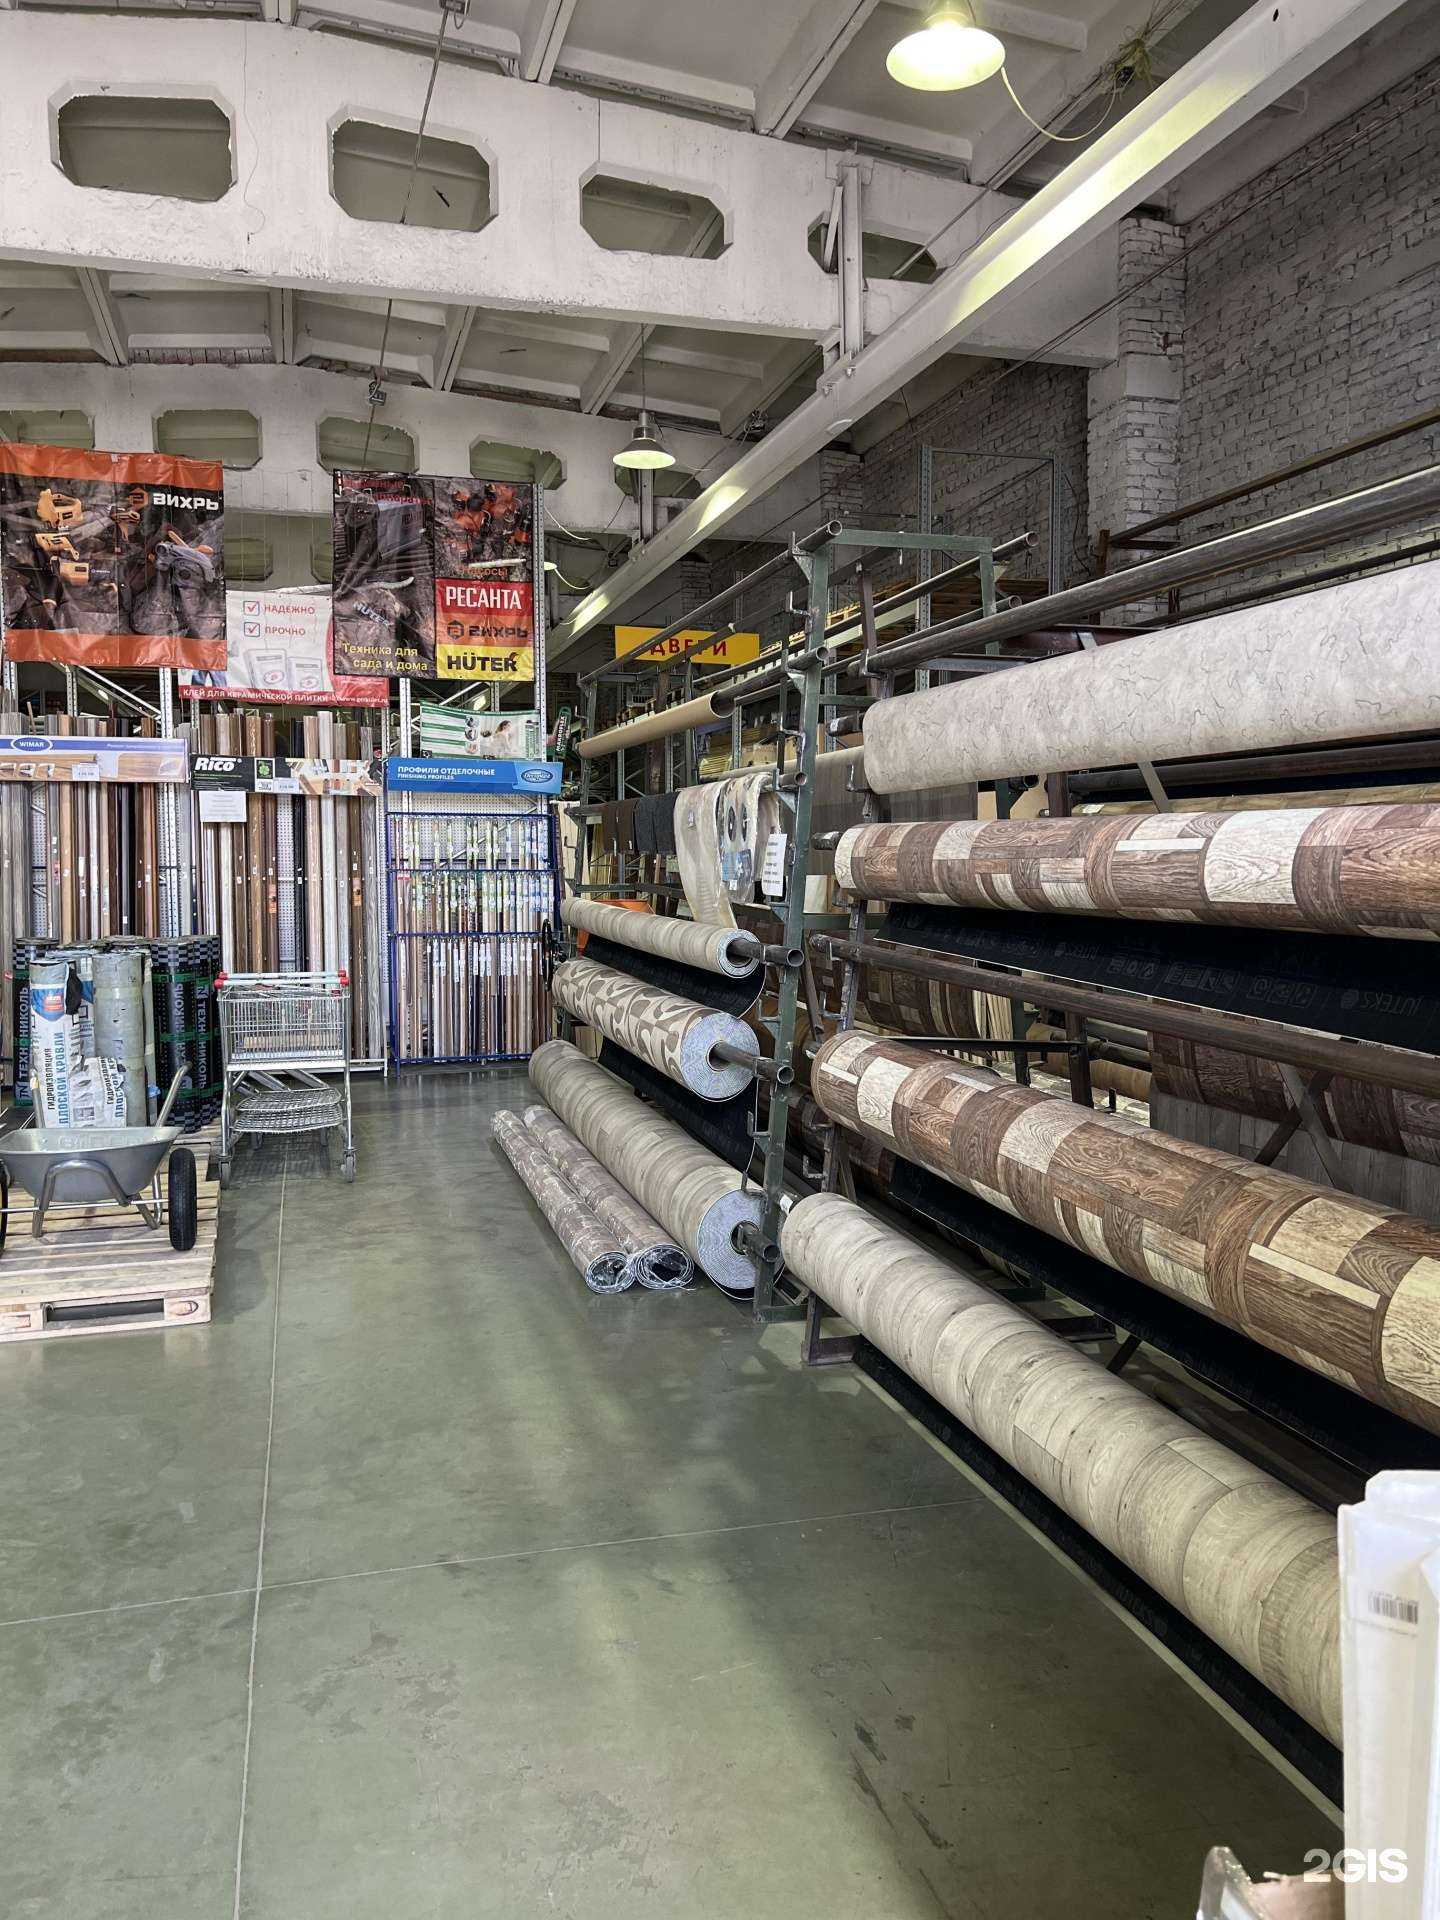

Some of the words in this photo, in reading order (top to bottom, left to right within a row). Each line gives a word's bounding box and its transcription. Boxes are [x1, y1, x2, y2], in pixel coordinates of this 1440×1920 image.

[153, 492, 219, 511] ВИХРЬ
[445, 585, 522, 610] РЕСАНТА
[264, 604, 315, 615] НАДЕЖНО
[264, 626, 306, 636] ПРОЧНО
[342, 641, 392, 656] Техника
[394, 646, 419, 658] для
[353, 659, 383, 670] сада
[386, 660, 393, 670] и
[397, 660, 428, 672] дома
[447, 652, 519, 672] HÜTER
[183, 687, 206, 697] КЛЕЙ
[206, 689, 225, 698] ДЛЯ
[227, 690, 292, 702] КЕРАМИЧЕСКОЙ
[294, 692, 328, 702] ПЛИТКИ
[19, 740, 45, 748] WIMAR
[397, 765, 439, 775] ПРОФИЛИ
[440, 766, 496, 776] ОТДЕЛОЧНЫЕ
[54, 1032, 66, 1072] КРОВЛИ
[43, 1048, 56, 1110] ГИДРОИЗОЛЯЦИЯ
[54, 1076, 69, 1124] ПЛОСКОЙ
